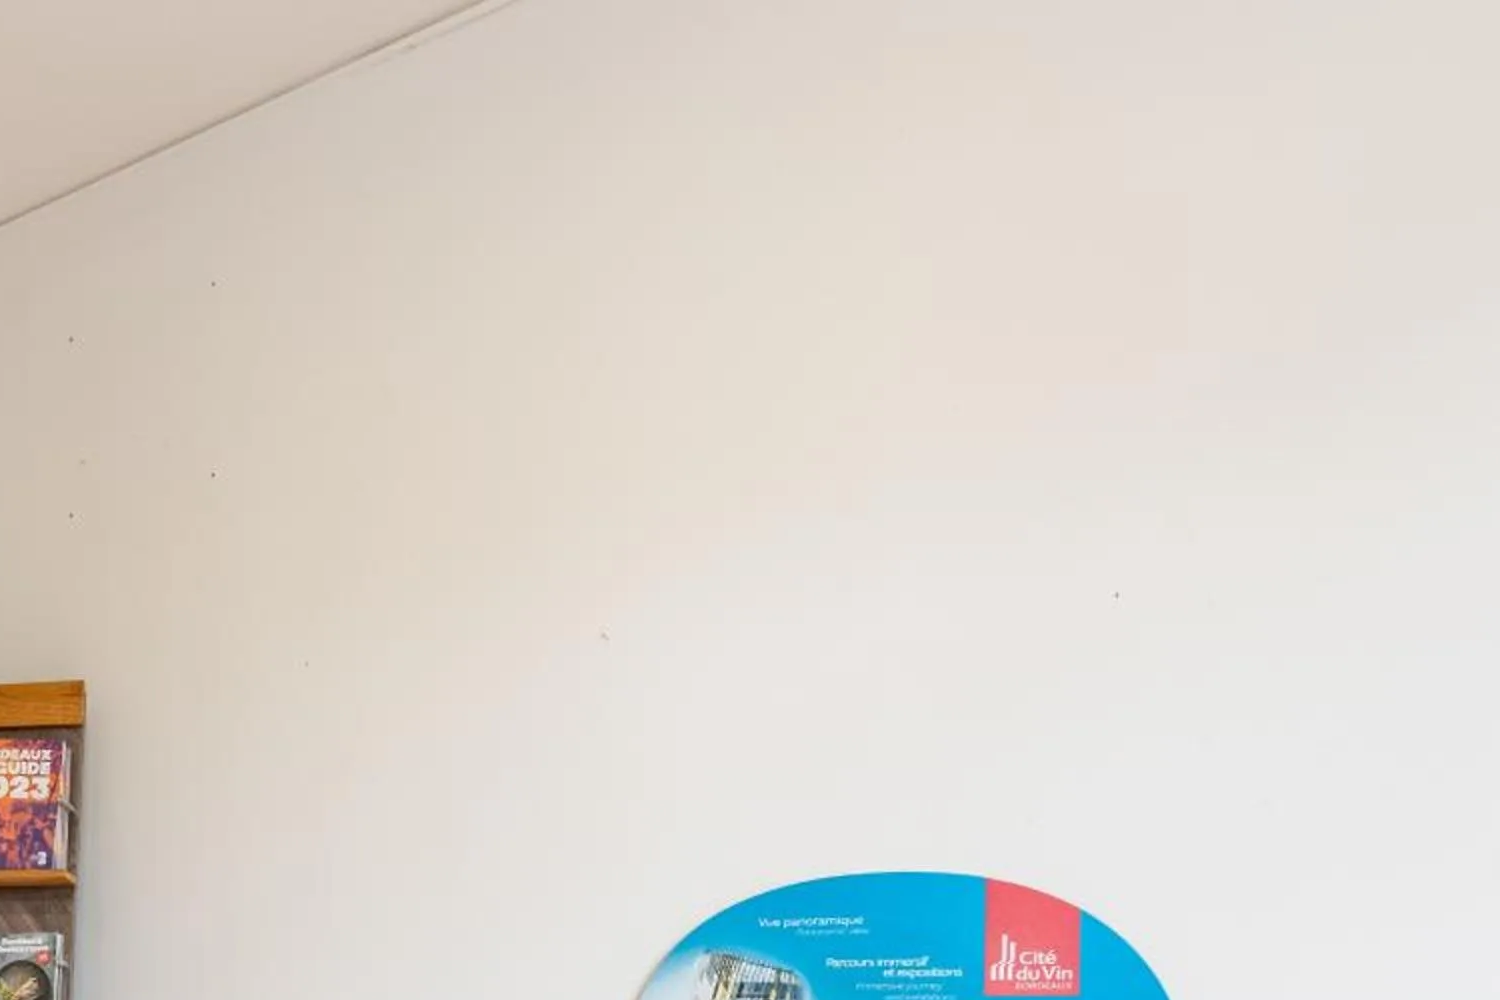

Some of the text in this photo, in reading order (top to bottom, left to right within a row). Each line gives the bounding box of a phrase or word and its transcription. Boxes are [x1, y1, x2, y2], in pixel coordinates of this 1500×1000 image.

[758, 915, 864, 929] Vue panoramique
[825, 956, 930, 968] Parcours immersif
[1019, 949, 1057, 965] Cité
[1016, 966, 1073, 980] du Vin
